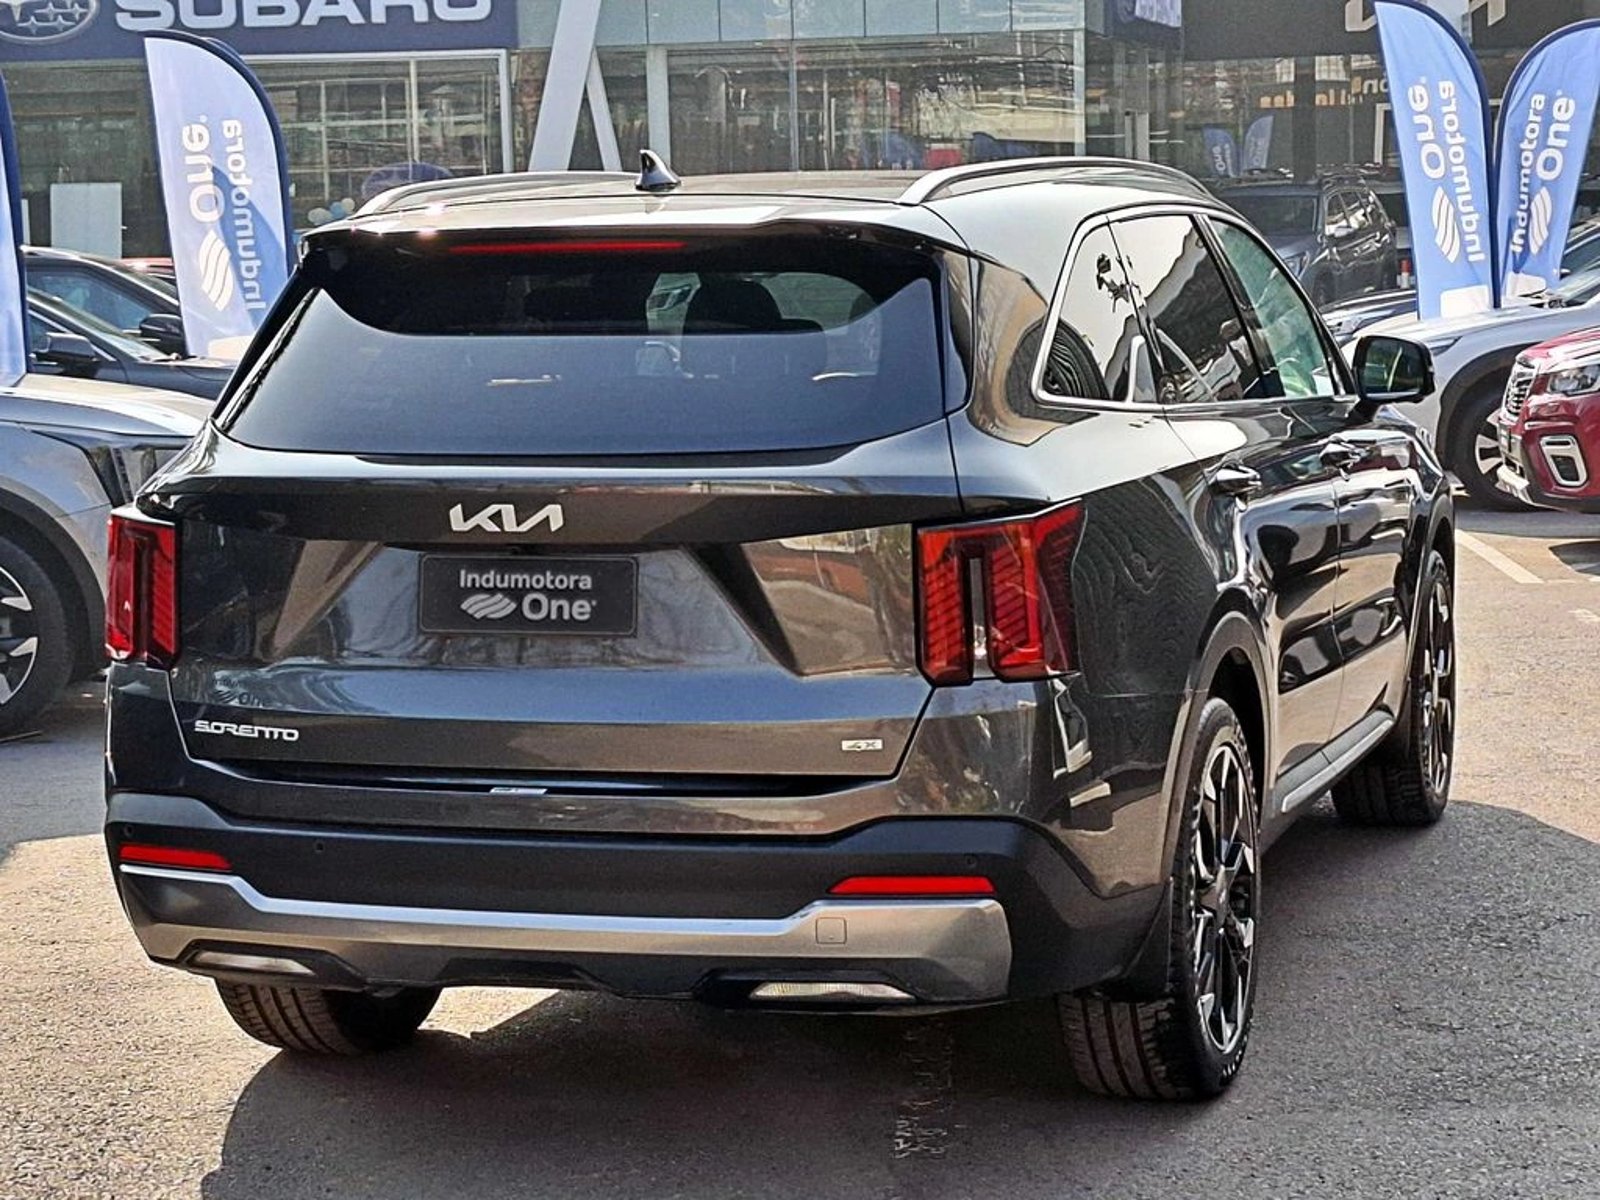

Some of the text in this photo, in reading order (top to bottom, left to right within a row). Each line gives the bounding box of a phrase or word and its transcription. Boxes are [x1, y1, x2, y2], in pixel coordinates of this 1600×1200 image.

[1535, 97, 1576, 180] One
[1511, 94, 1546, 253] Indumotora
[449, 503, 564, 532] KIA
[459, 569, 592, 590] Indumotora
[521, 593, 592, 621] One
[194, 720, 299, 741] SORENTO
